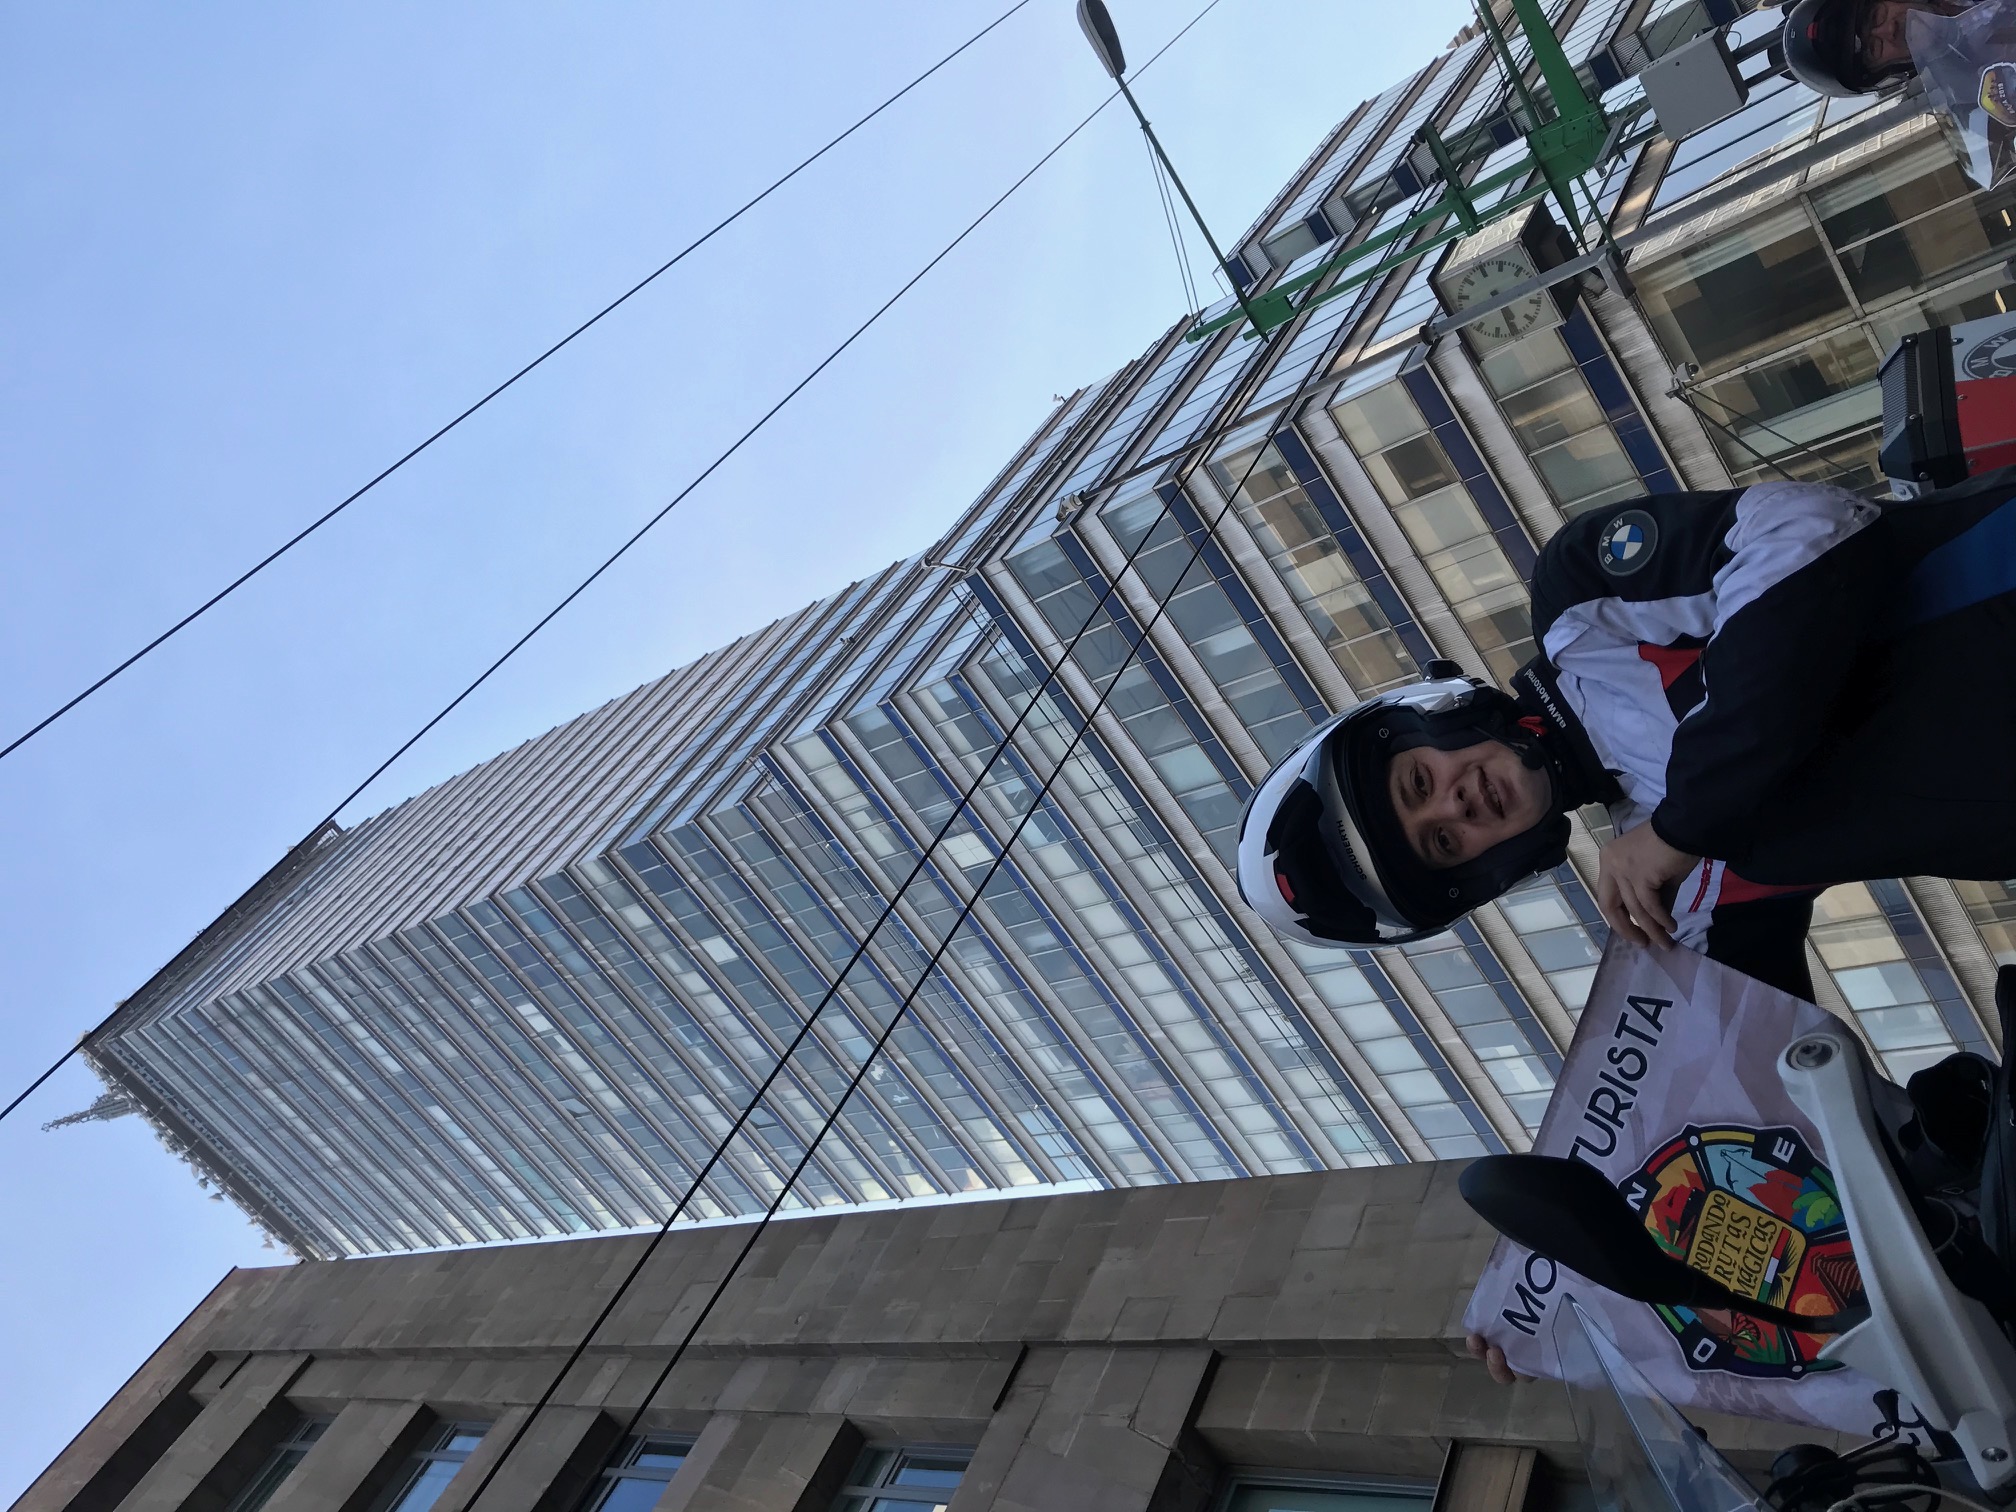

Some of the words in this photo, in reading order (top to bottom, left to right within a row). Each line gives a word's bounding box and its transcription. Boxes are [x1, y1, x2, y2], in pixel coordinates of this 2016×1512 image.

[1998, 82, 2006, 98] 2019
[1602, 518, 1624, 564] BMW
[1524, 668, 1550, 703] Motorrad
[1546, 703, 1567, 729] BMW
[1336, 820, 1367, 880] SCHUBERTH
[1501, 994, 1674, 1337] MOTURISTA
[1771, 1136, 1797, 1163] E
[1625, 1181, 1649, 1211] N
[1713, 1212, 1752, 1284] RUTAS
[1693, 1337, 1718, 1362] O
